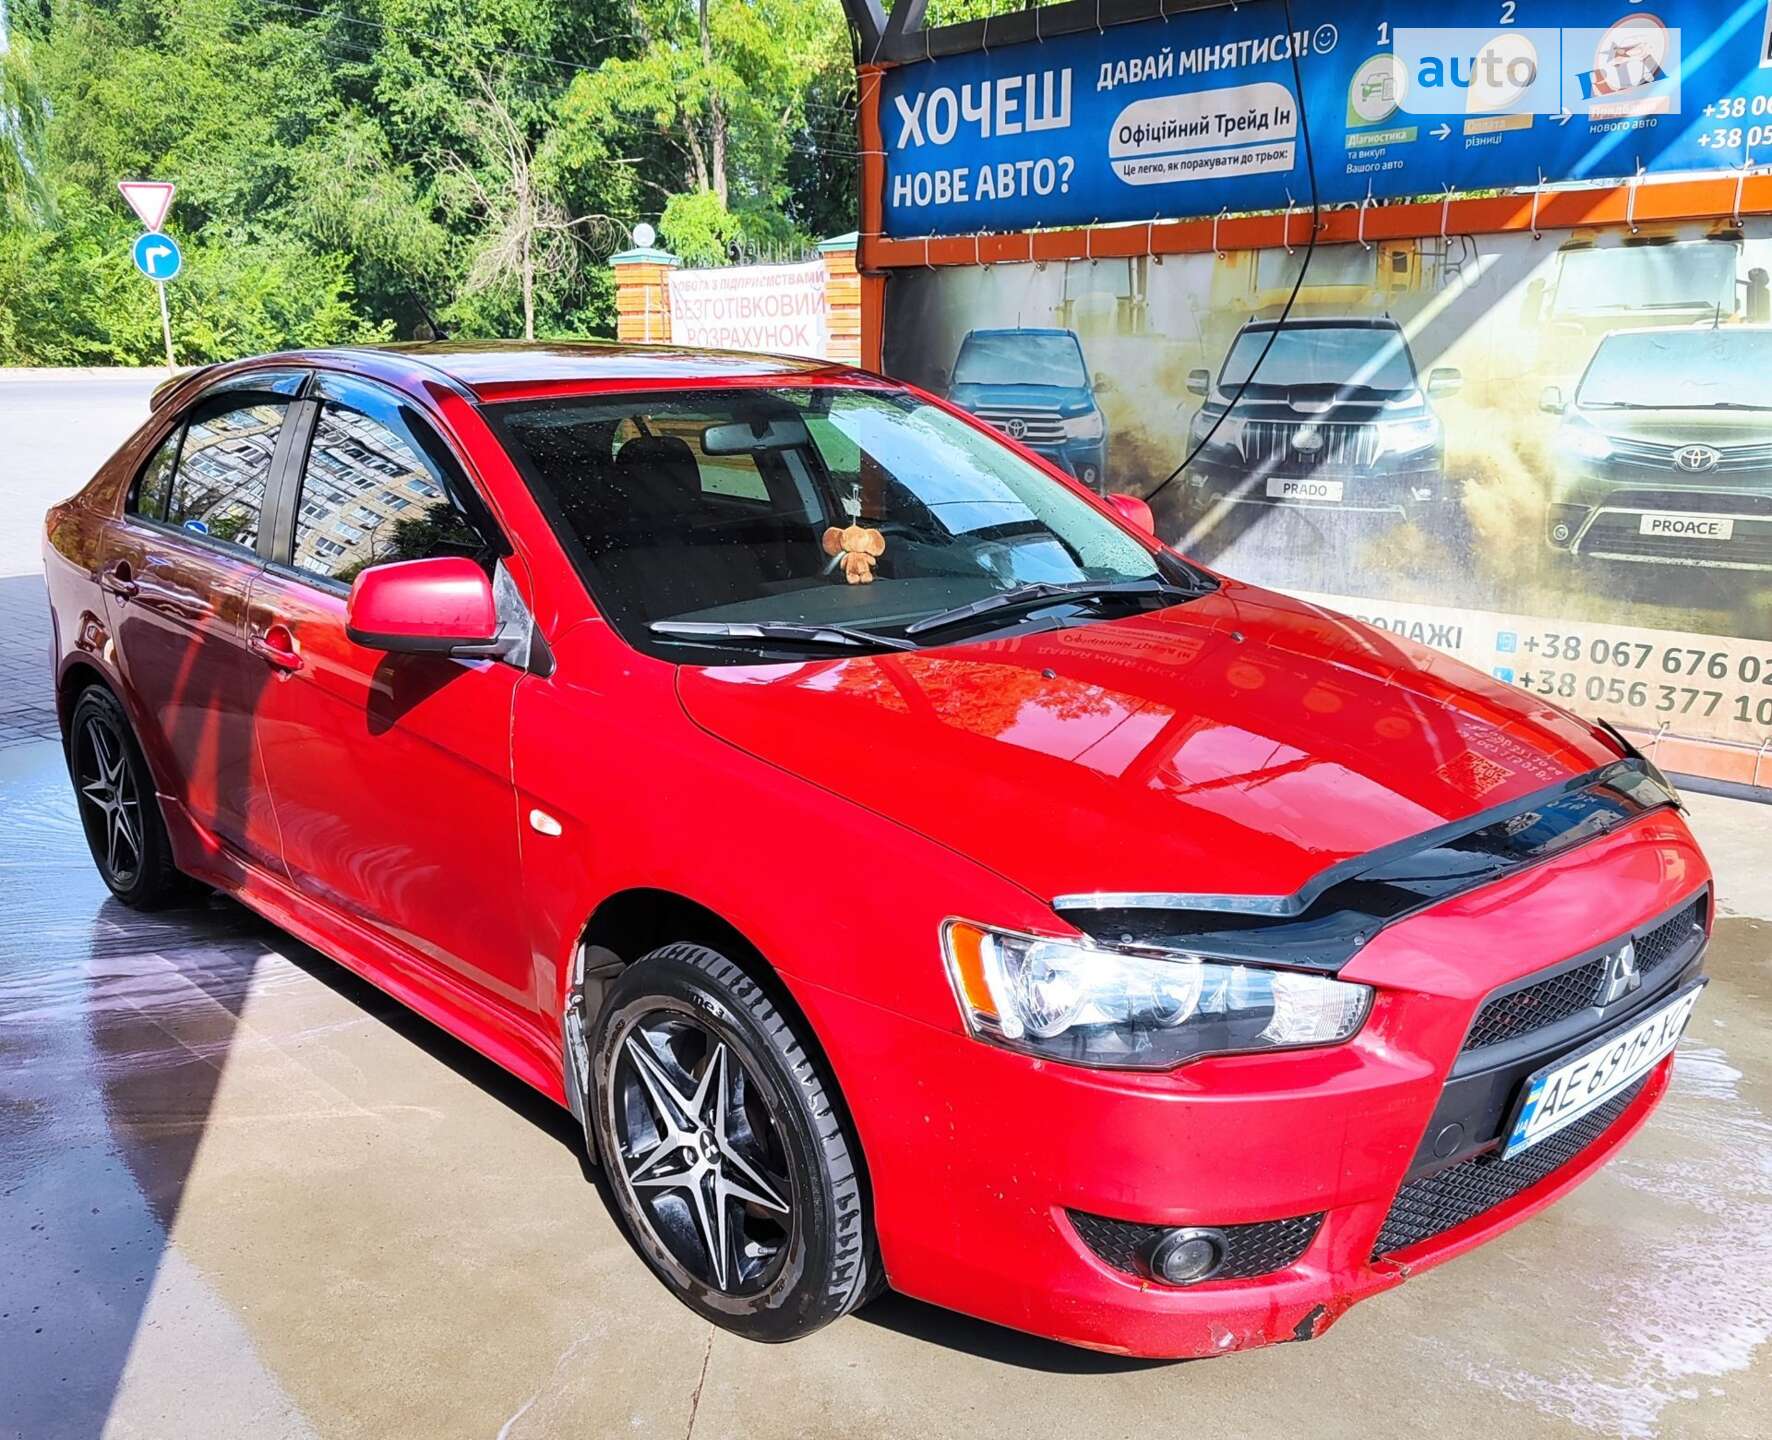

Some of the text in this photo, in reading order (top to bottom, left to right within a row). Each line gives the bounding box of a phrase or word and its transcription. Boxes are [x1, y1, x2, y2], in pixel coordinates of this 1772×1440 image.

[1499, 1, 1516, 25] 2
[1376, 22, 1390, 45] 1
[1097, 30, 1310, 92] ДАВАЙ МІНЯТИСЯ!
[893, 67, 1073, 150] ХОЧЕШ
[1702, 97, 1746, 119] +38
[1119, 106, 1291, 148] Офіційний Трейд Ін
[1590, 118, 1658, 134] нового авто
[1348, 131, 1408, 146] Діагностика
[1465, 132, 1503, 150] різниці
[1698, 127, 1742, 149] +38
[1123, 149, 1289, 177] Це легко, як порахувати до трьох:
[1348, 148, 1386, 160] та викуп
[1346, 160, 1404, 174] Вашого авто
[892, 156, 1074, 208] НОВЕ АВТО?
[687, 324, 809, 348] РОЗРАХУНОК
[1283, 483, 1328, 496] PRADO
[1652, 520, 1719, 535] PROACE
[1523, 633, 1581, 661] +38
[1590, 639, 1654, 669] 067
[1661, 647, 1729, 679] 676
[1518, 670, 1772, 725] +38 056 377 10
[1533, 1063, 1591, 1125] AE
[1587, 1025, 1654, 1094] 6919
